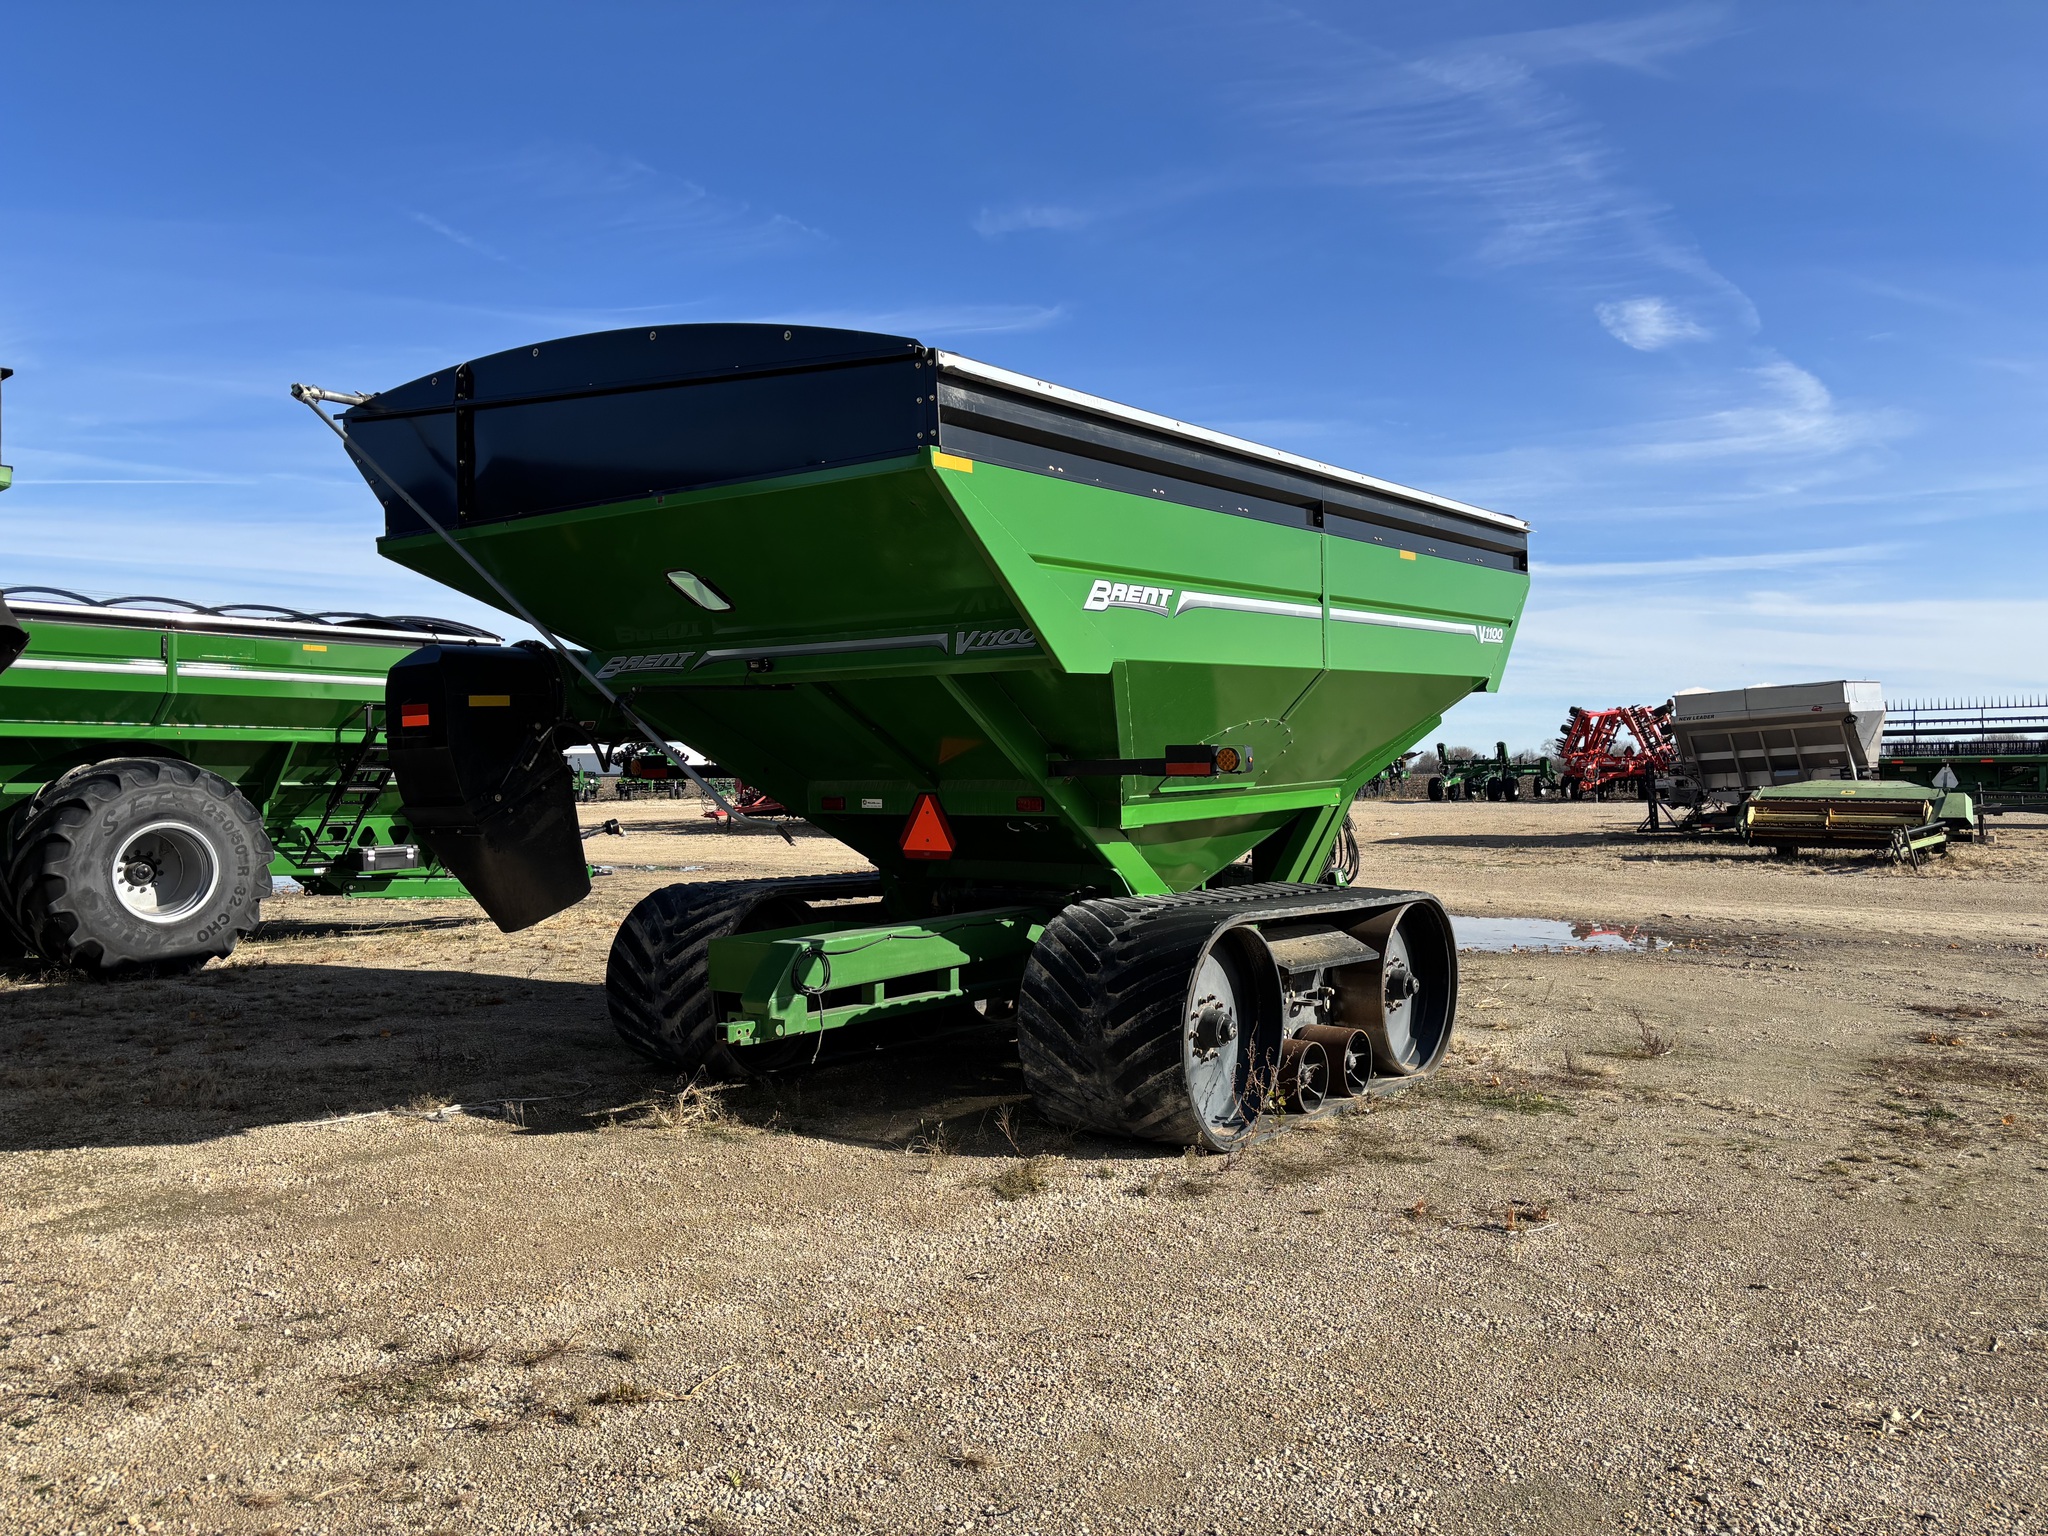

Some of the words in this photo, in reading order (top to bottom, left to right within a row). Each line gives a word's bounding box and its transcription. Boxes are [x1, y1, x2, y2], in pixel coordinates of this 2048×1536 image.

[1083, 579, 1174, 614] BRENT
[955, 629, 1037, 654] V1100
[1478, 625, 1503, 643] V1100
[595, 651, 697, 679] BRENT
